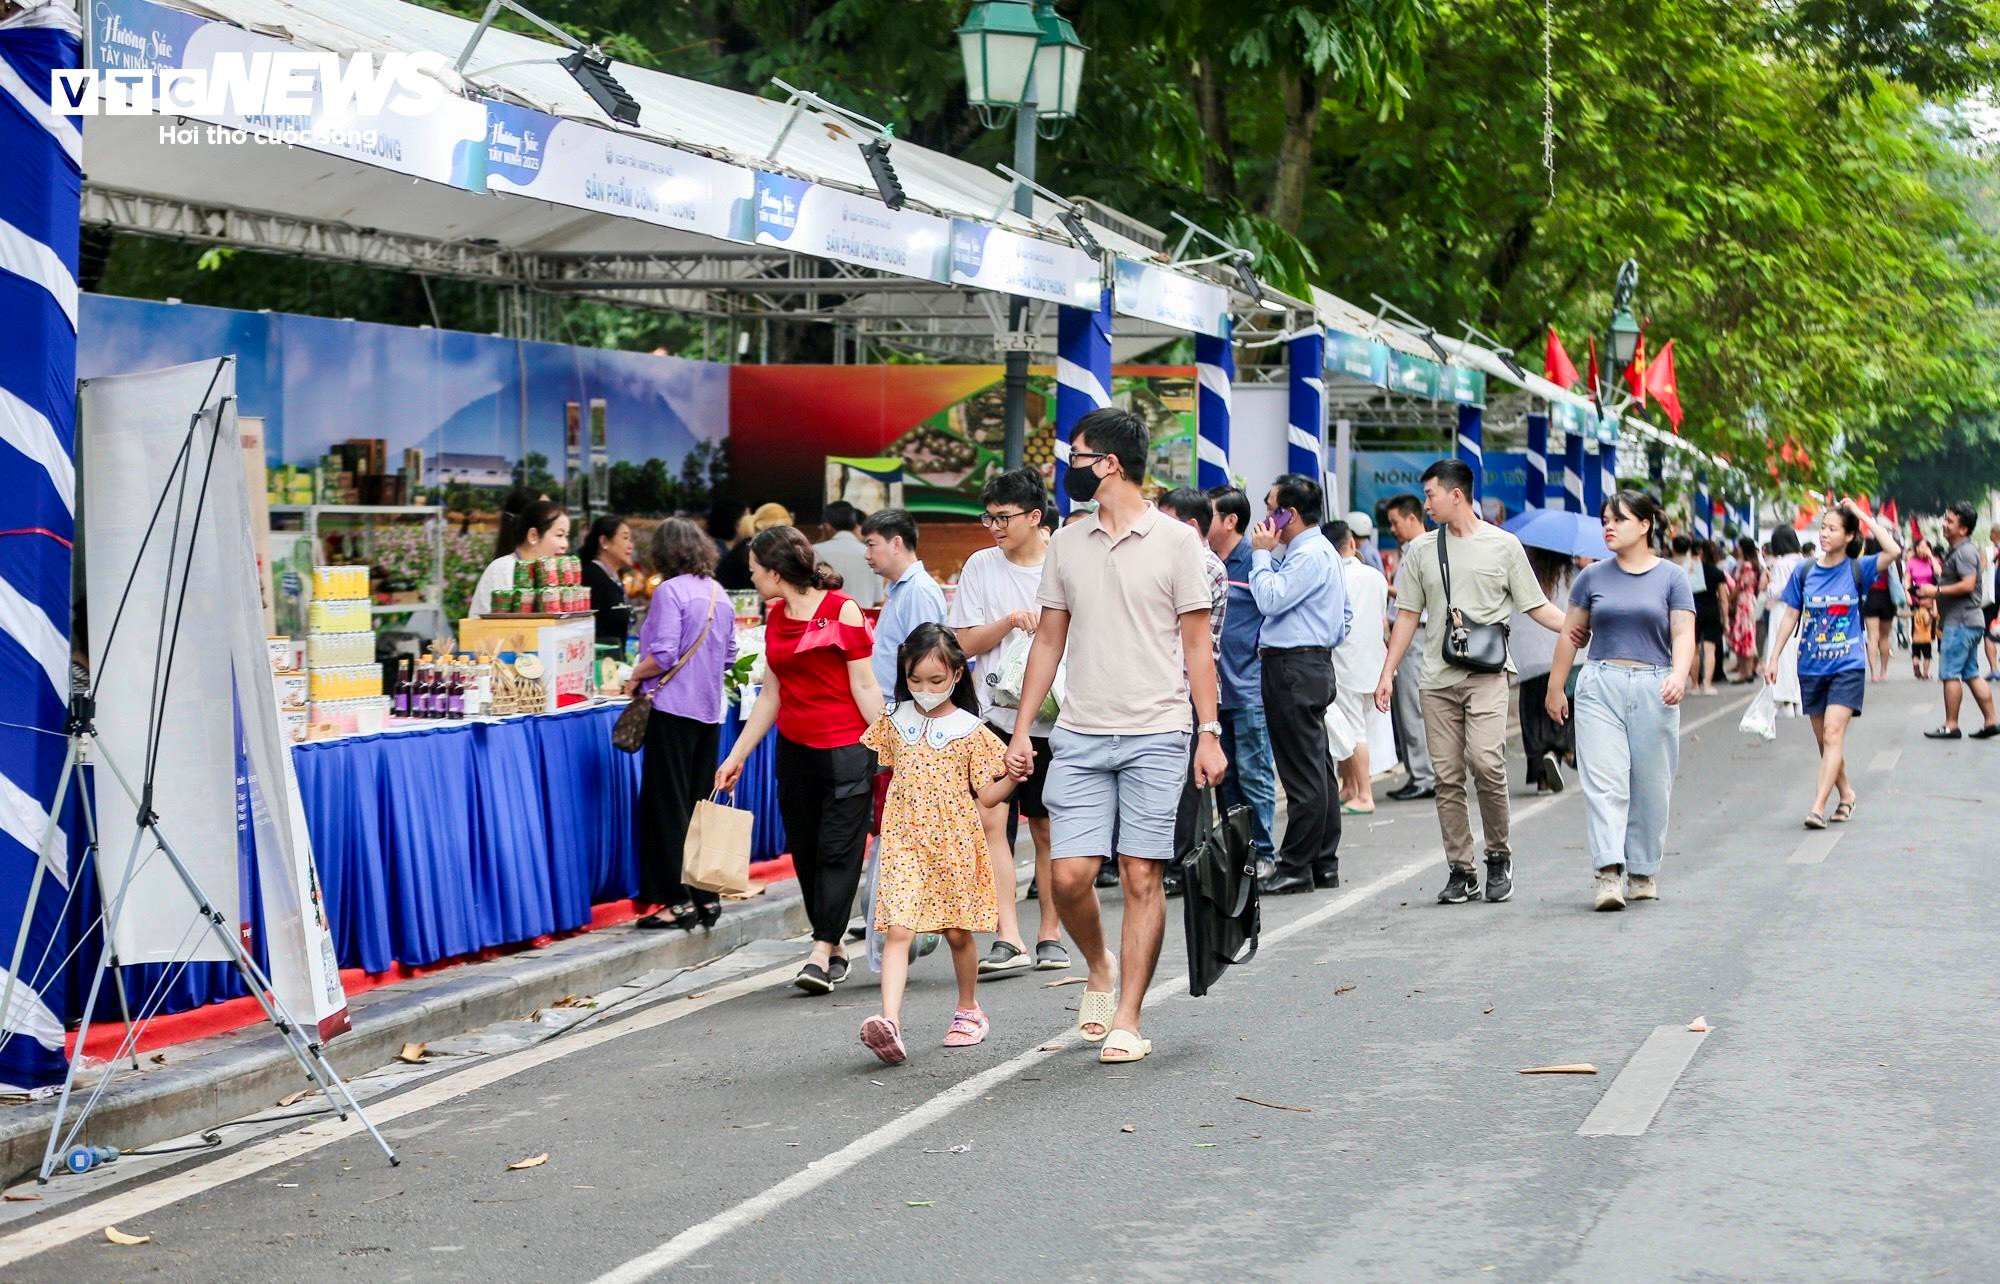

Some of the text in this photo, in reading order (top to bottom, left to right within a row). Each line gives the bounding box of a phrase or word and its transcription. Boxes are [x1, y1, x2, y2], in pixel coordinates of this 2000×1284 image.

[147, 31, 173, 59] Sắc
[100, 45, 175, 77] TÂY NINH 20
[488, 146, 503, 162] TÂY
[586, 173, 604, 202] SẢN
[607, 176, 632, 207] PHẨM
